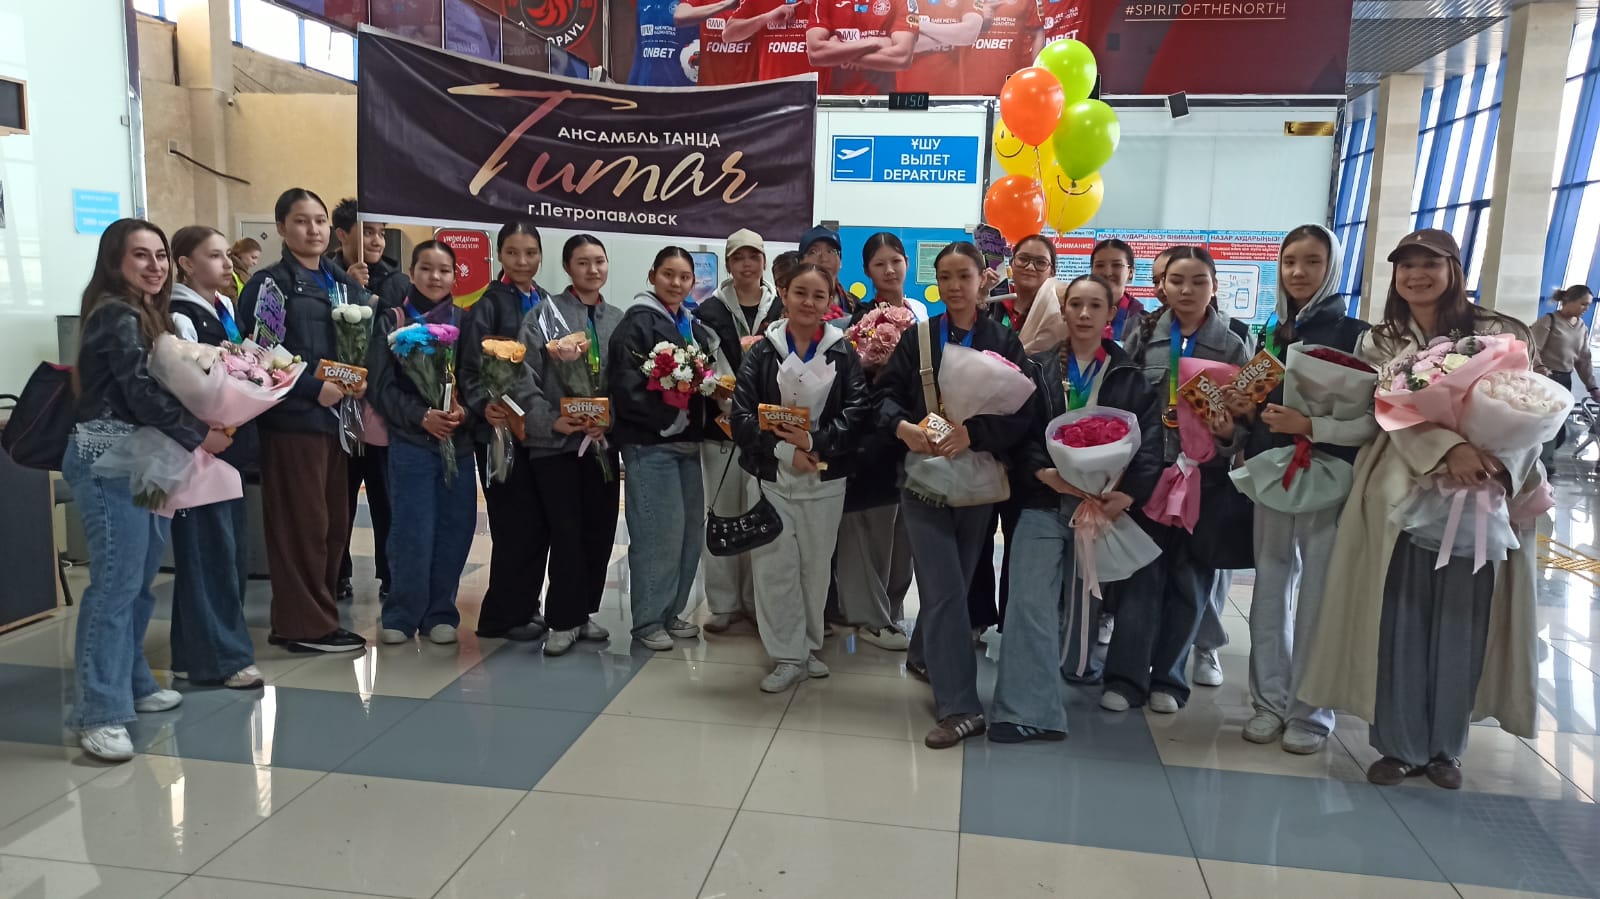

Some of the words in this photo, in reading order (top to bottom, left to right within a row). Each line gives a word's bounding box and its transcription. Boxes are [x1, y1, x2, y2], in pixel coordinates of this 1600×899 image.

[1125, 2, 1287, 16] #SPIRITOFTHENORTH
[706, 42, 751, 53] FONBET
[447, 83, 759, 204] Tumar
[557, 126, 659, 145] АНСАМБЛЬ
[663, 132, 721, 149] ТАНЦА
[911, 138, 942, 150] ҰШУ
[901, 154, 950, 166] ВЫЛЕТ
[883, 169, 966, 182] DEPARTURE
[527, 203, 678, 226] г.Петропавловск
[323, 366, 362, 382] Toffifee
[564, 401, 606, 414] Toffifee
[762, 411, 806, 424] Toffifee
